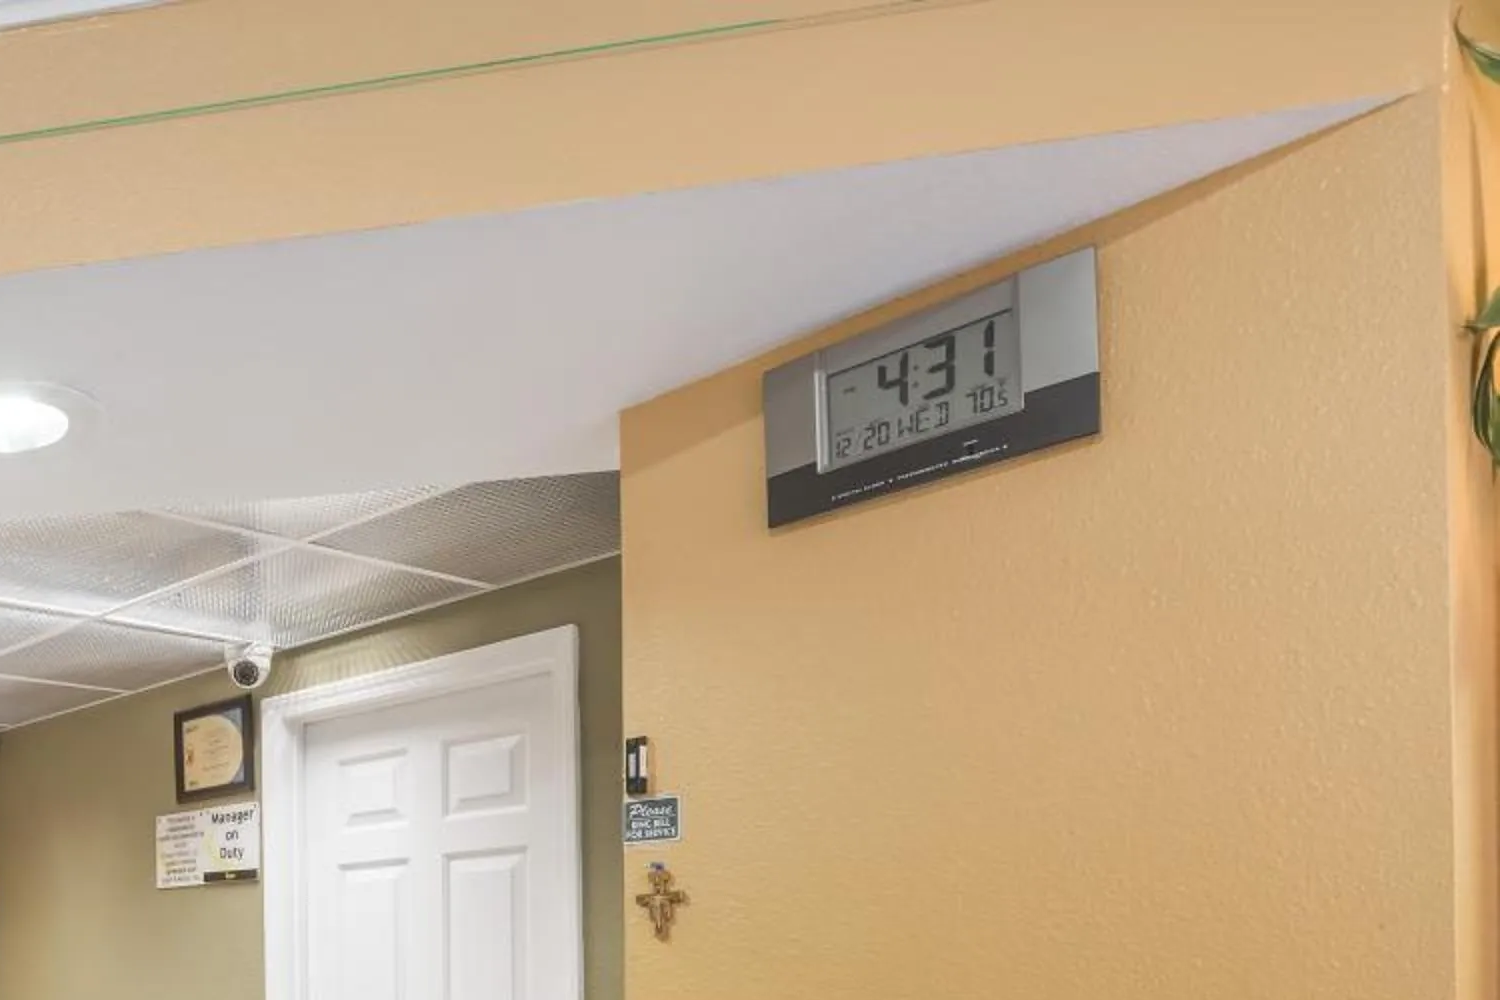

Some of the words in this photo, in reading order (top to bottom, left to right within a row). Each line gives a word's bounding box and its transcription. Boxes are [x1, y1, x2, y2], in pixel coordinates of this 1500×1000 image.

[877, 319, 996, 407] 4:31
[898, 401, 950, 438] WED
[212, 808, 254, 825] Manager
[629, 803, 673, 818] Please
[225, 830, 239, 841] on
[220, 847, 245, 860] Duty
